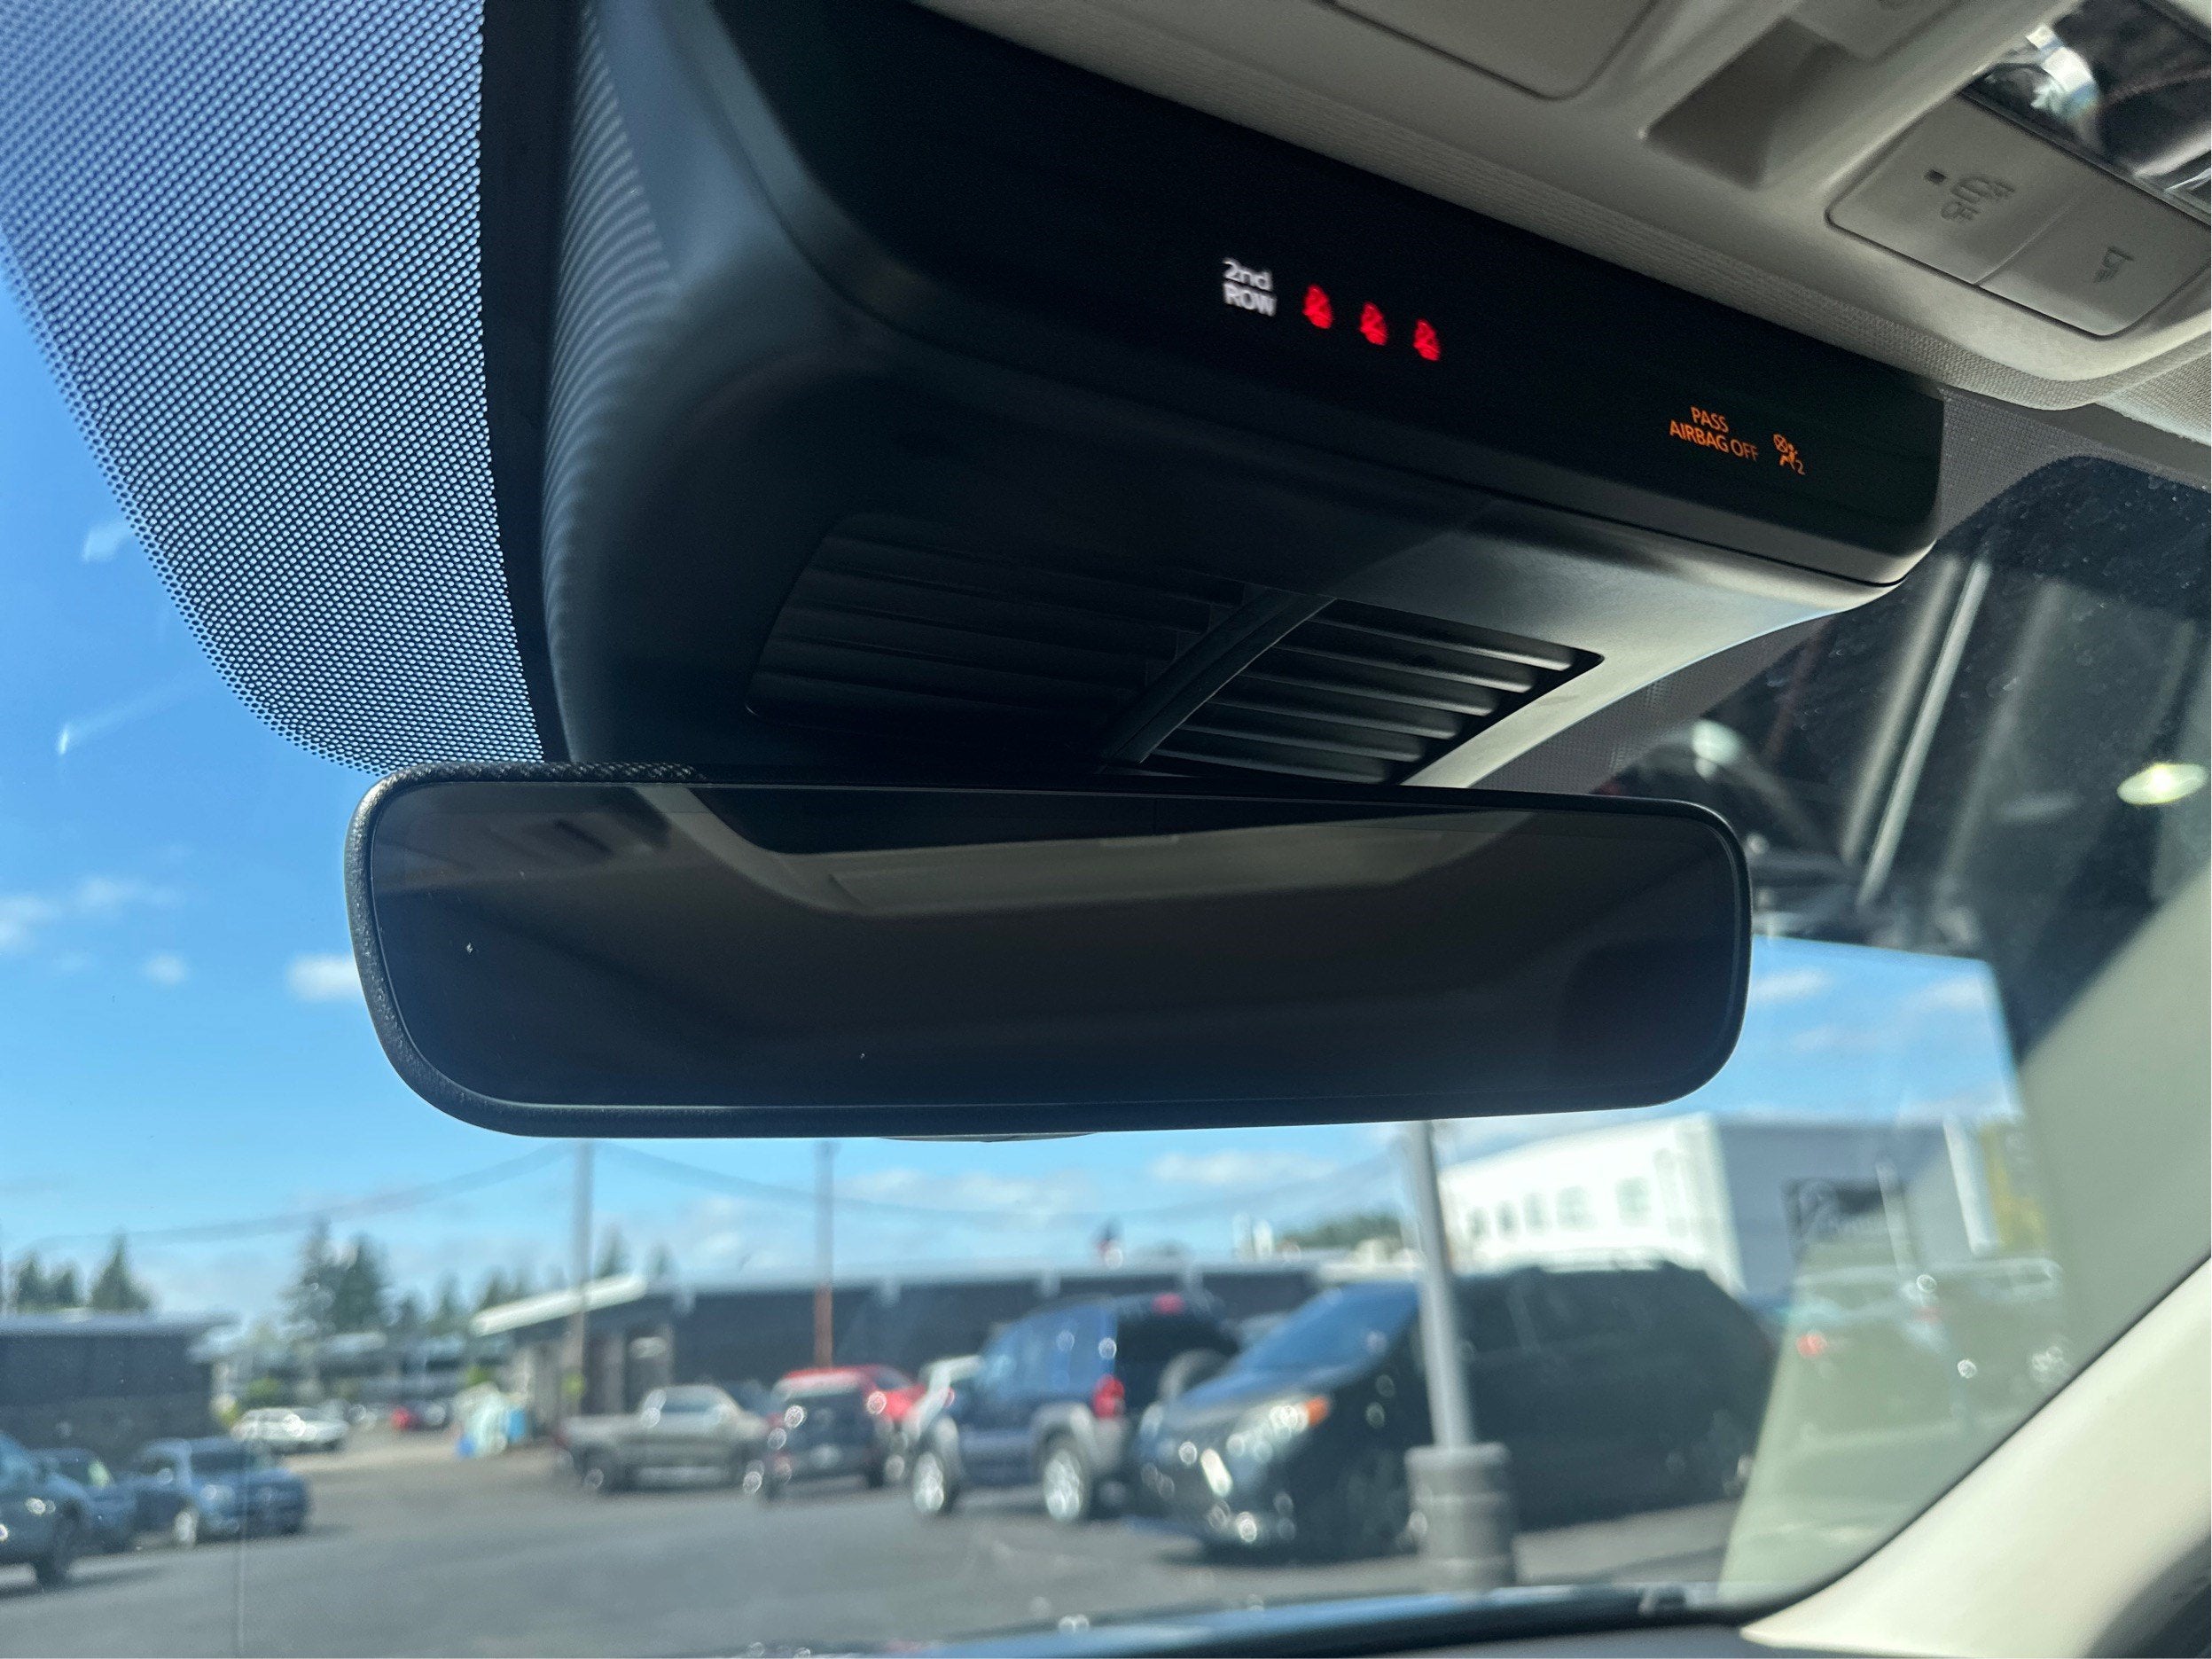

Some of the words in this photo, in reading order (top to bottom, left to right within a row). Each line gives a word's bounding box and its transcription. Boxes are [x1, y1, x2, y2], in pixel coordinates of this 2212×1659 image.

[1223, 257, 1273, 292] 2nd
[1223, 280, 1277, 317] ROW
[1691, 405, 1729, 433] PASS
[1669, 419, 1729, 453] AIRBAG
[1731, 438, 1758, 461] OFF
